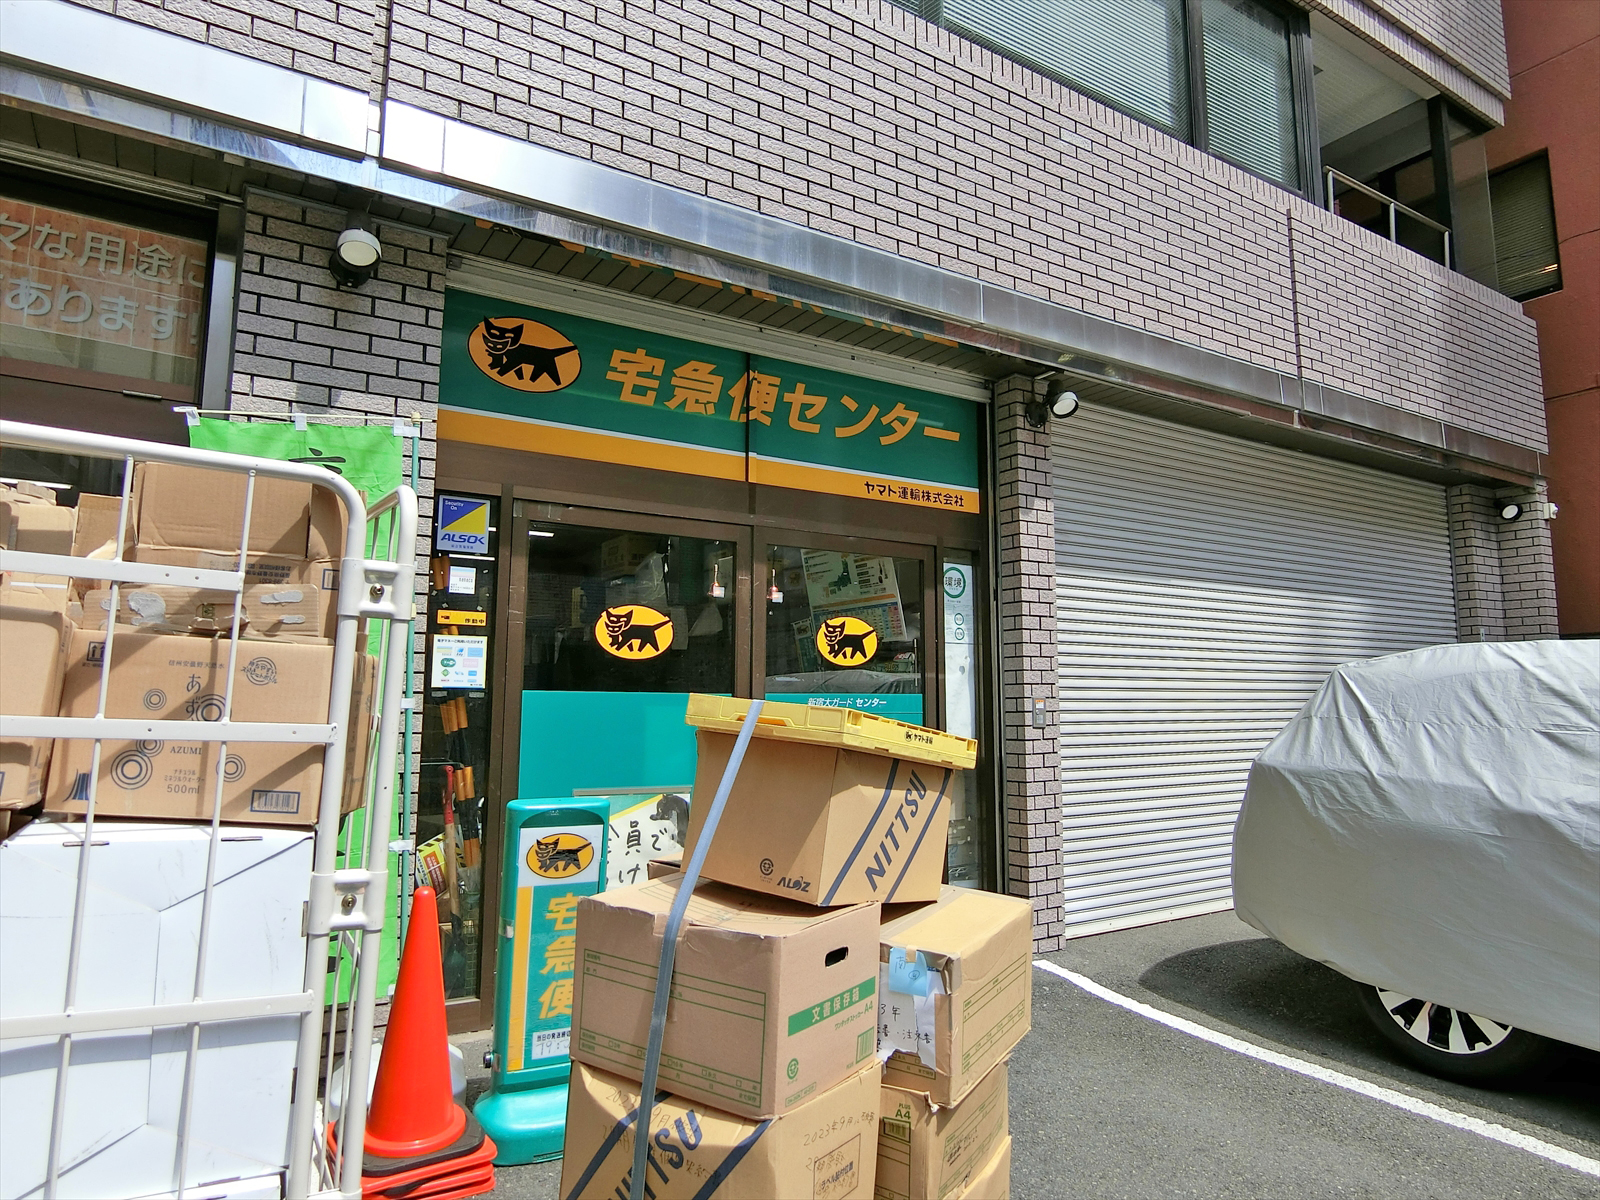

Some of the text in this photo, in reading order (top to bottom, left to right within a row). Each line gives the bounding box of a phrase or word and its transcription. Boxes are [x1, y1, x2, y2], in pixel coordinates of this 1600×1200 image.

[0, 274, 200, 345] あります!
[606, 348, 960, 446] 宅急便センター
[864, 481, 965, 507] ヤマト運輸株式会社
[441, 533, 485, 545] ALSOK
[185, 673, 202, 721] あず
[855, 697, 887, 708] センター
[170, 746, 202, 755] AZUMI
[166, 783, 200, 794] 500ml
[608, 820, 668, 856] 員で
[865, 769, 927, 892] NITTSU
[811, 987, 860, 1023] 文書保存箱
[895, 1108, 912, 1120] A4
